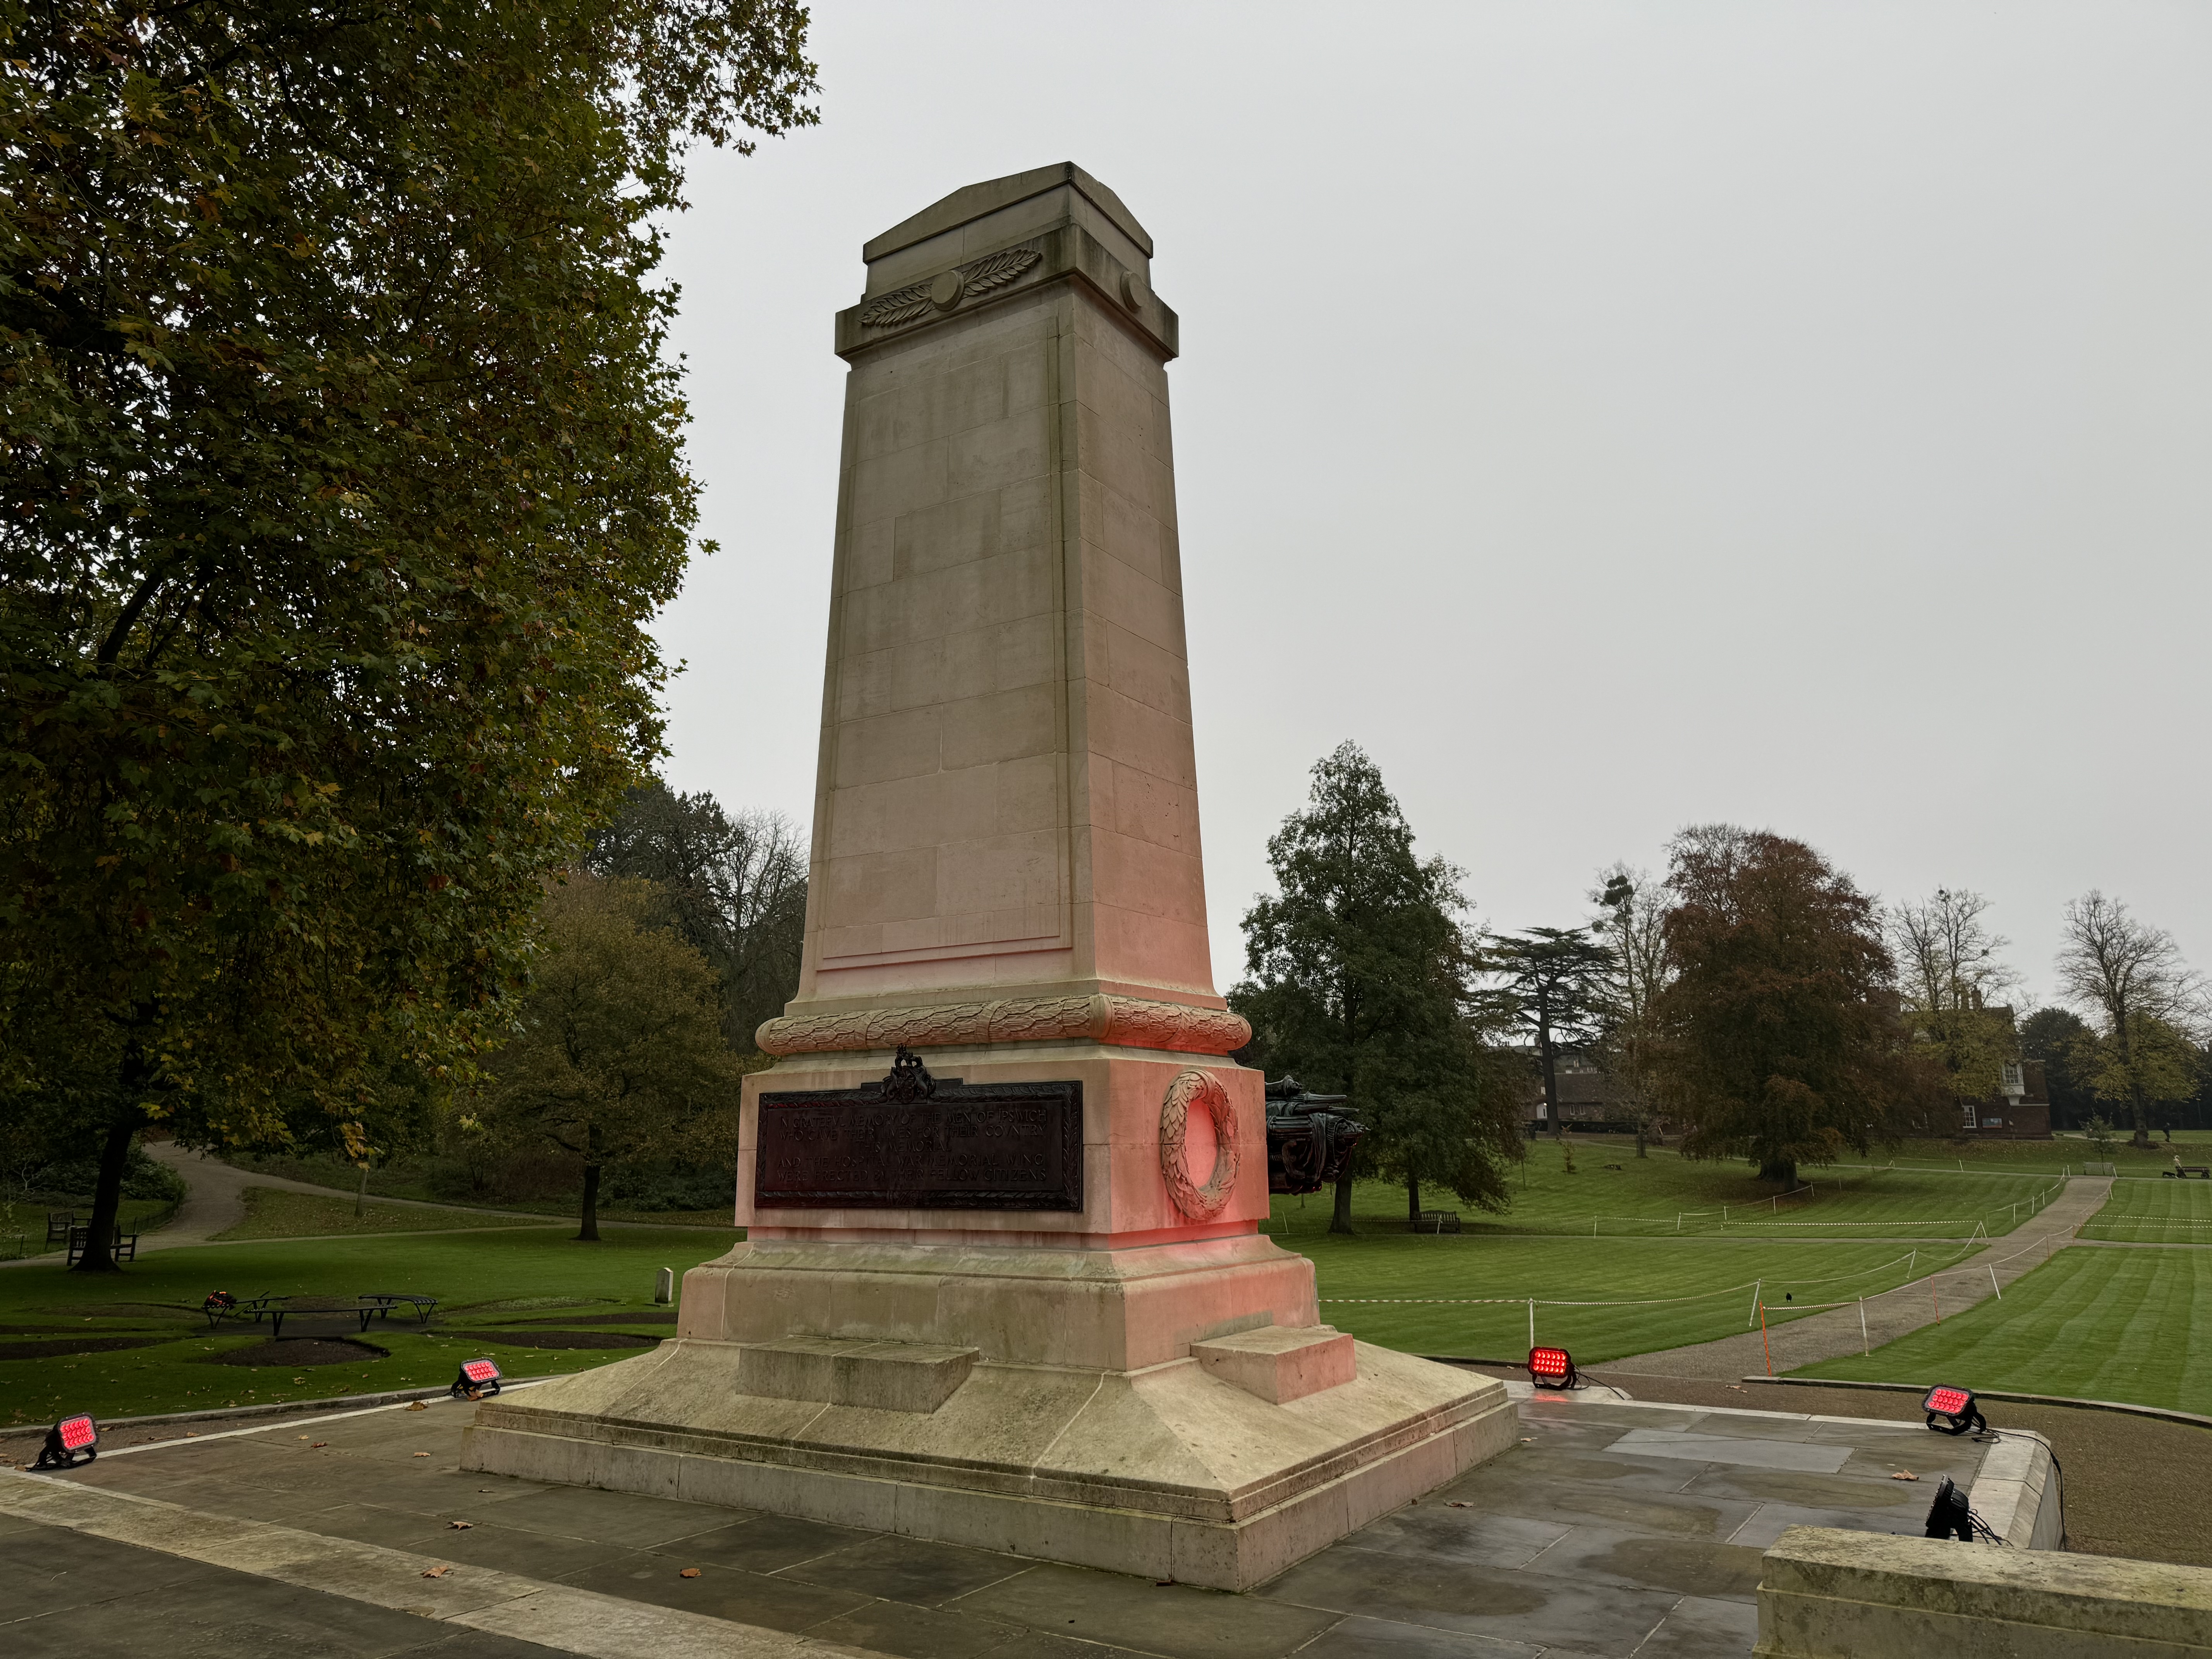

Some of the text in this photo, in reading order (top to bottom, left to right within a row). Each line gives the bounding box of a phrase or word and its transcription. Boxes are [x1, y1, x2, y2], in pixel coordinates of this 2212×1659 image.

[850, 1114, 897, 1127] MEMORY
[901, 1113, 915, 1125] OF
[920, 1113, 941, 1124] THE
[946, 1111, 971, 1124] MEN
[976, 1111, 994, 1123] OF
[999, 1108, 1046, 1123] IPSWICH
[779, 1130, 804, 1141] WHO
[917, 1127, 939, 1138] FOR
[944, 1125, 979, 1137] THEIR
[889, 1139, 952, 1152] MEMORIAL
[778, 1156, 801, 1168] AND
[805, 1156, 829, 1168] THE
[835, 1155, 891, 1167] HOSPITAL
[896, 1155, 922, 1166] WAR
[928, 1154, 998, 1166] MEMORIAL
[777, 1170, 809, 1182] WERE
[815, 1170, 869, 1181] ERECTED
[930, 1168, 980, 1181] FELLOW
[984, 1168, 1046, 1181] CITIZENS
